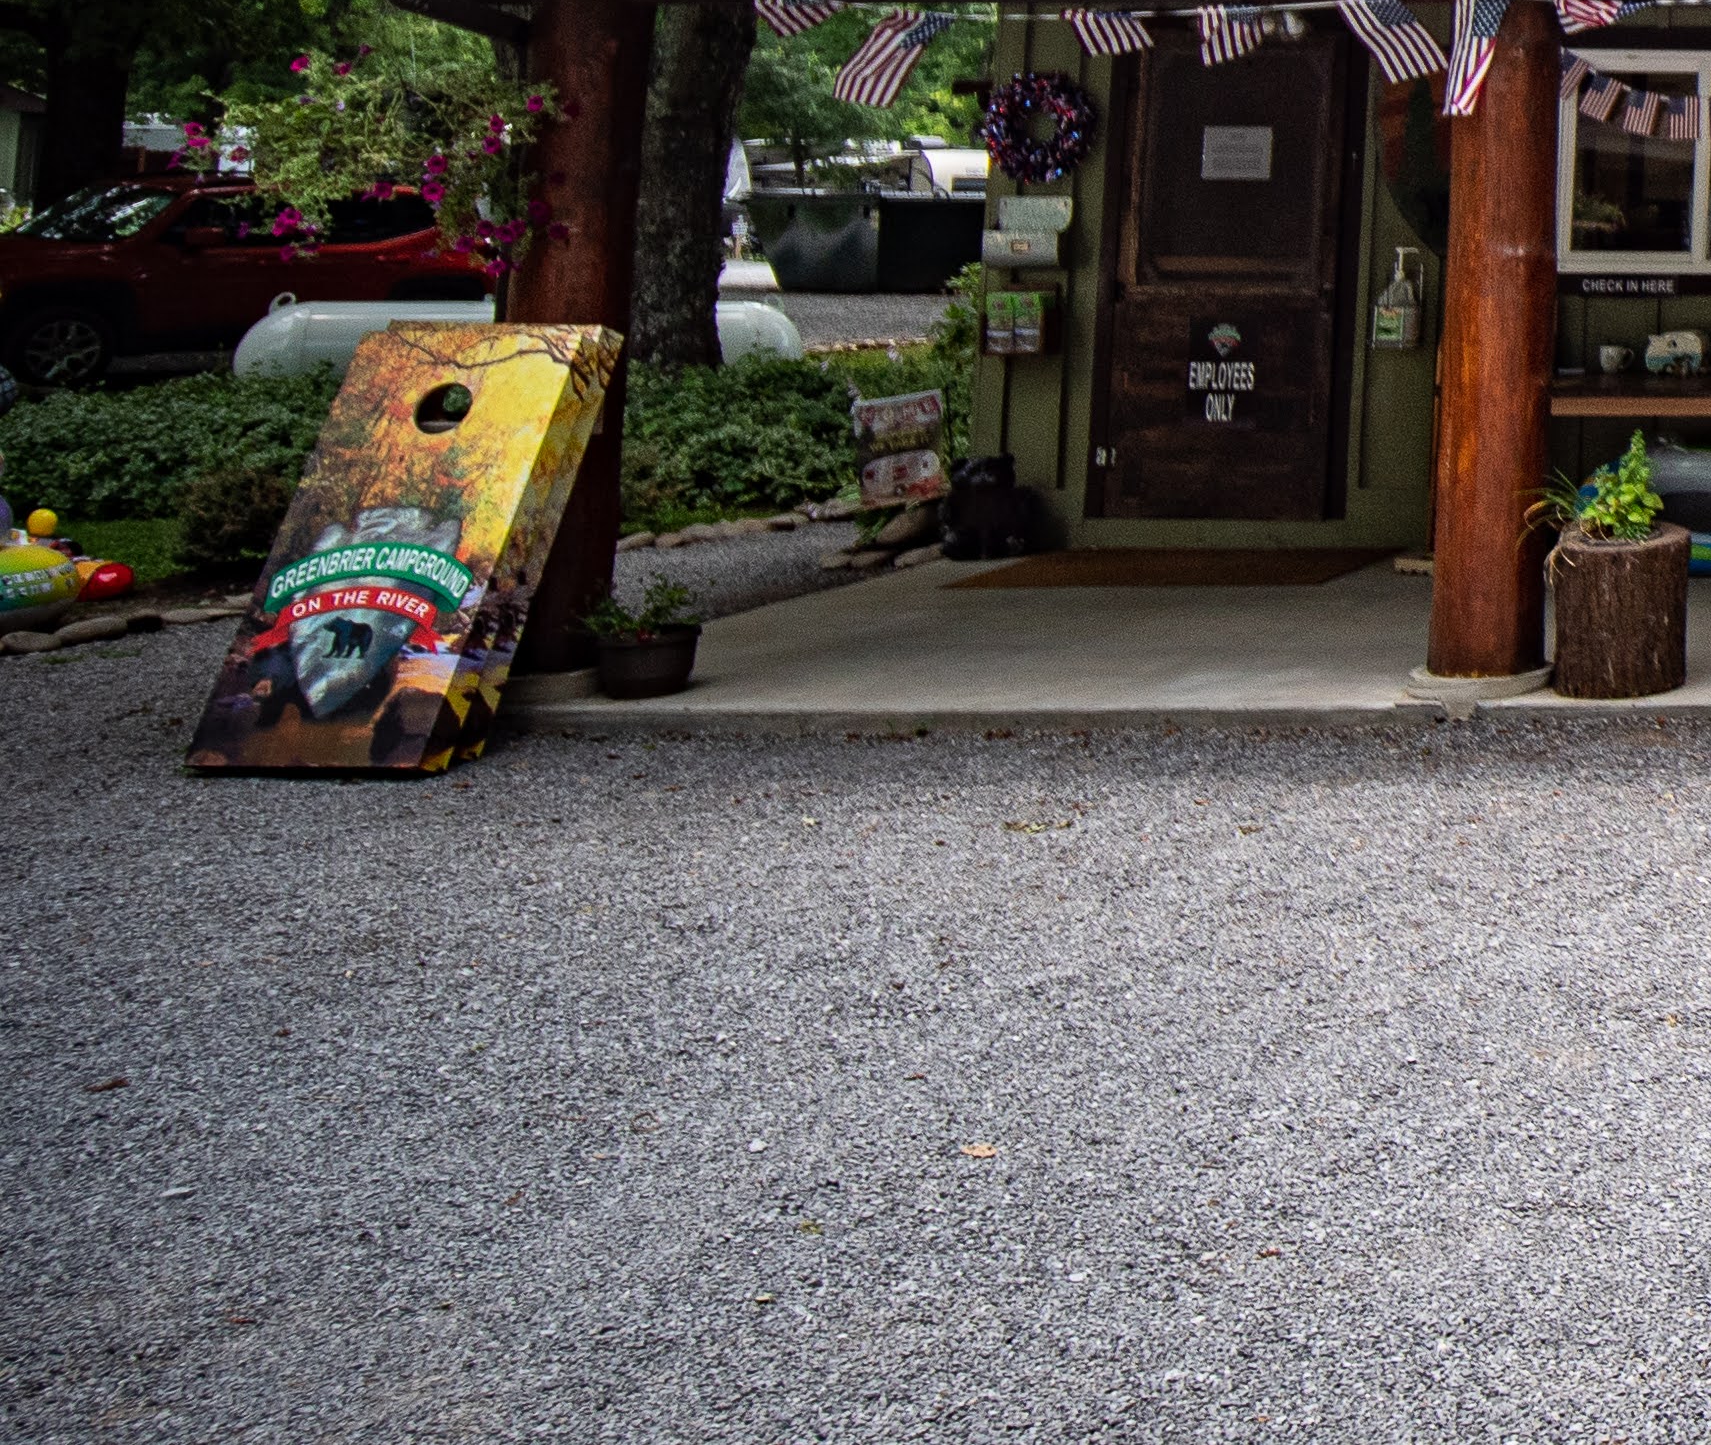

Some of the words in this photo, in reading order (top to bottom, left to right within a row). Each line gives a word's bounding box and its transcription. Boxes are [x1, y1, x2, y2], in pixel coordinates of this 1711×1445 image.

[1582, 278, 1624, 293] CHECK
[1626, 279, 1639, 293] IN
[1640, 279, 1674, 293] HERE
[1188, 361, 1256, 391] EMPLOYEES
[1205, 393, 1235, 422] ONLY
[271, 547, 372, 599] GREENBRIER
[375, 546, 470, 599] CAMPGROUND
[292, 597, 321, 617] ON
[332, 589, 370, 605] THE
[376, 590, 431, 618] RIVER
